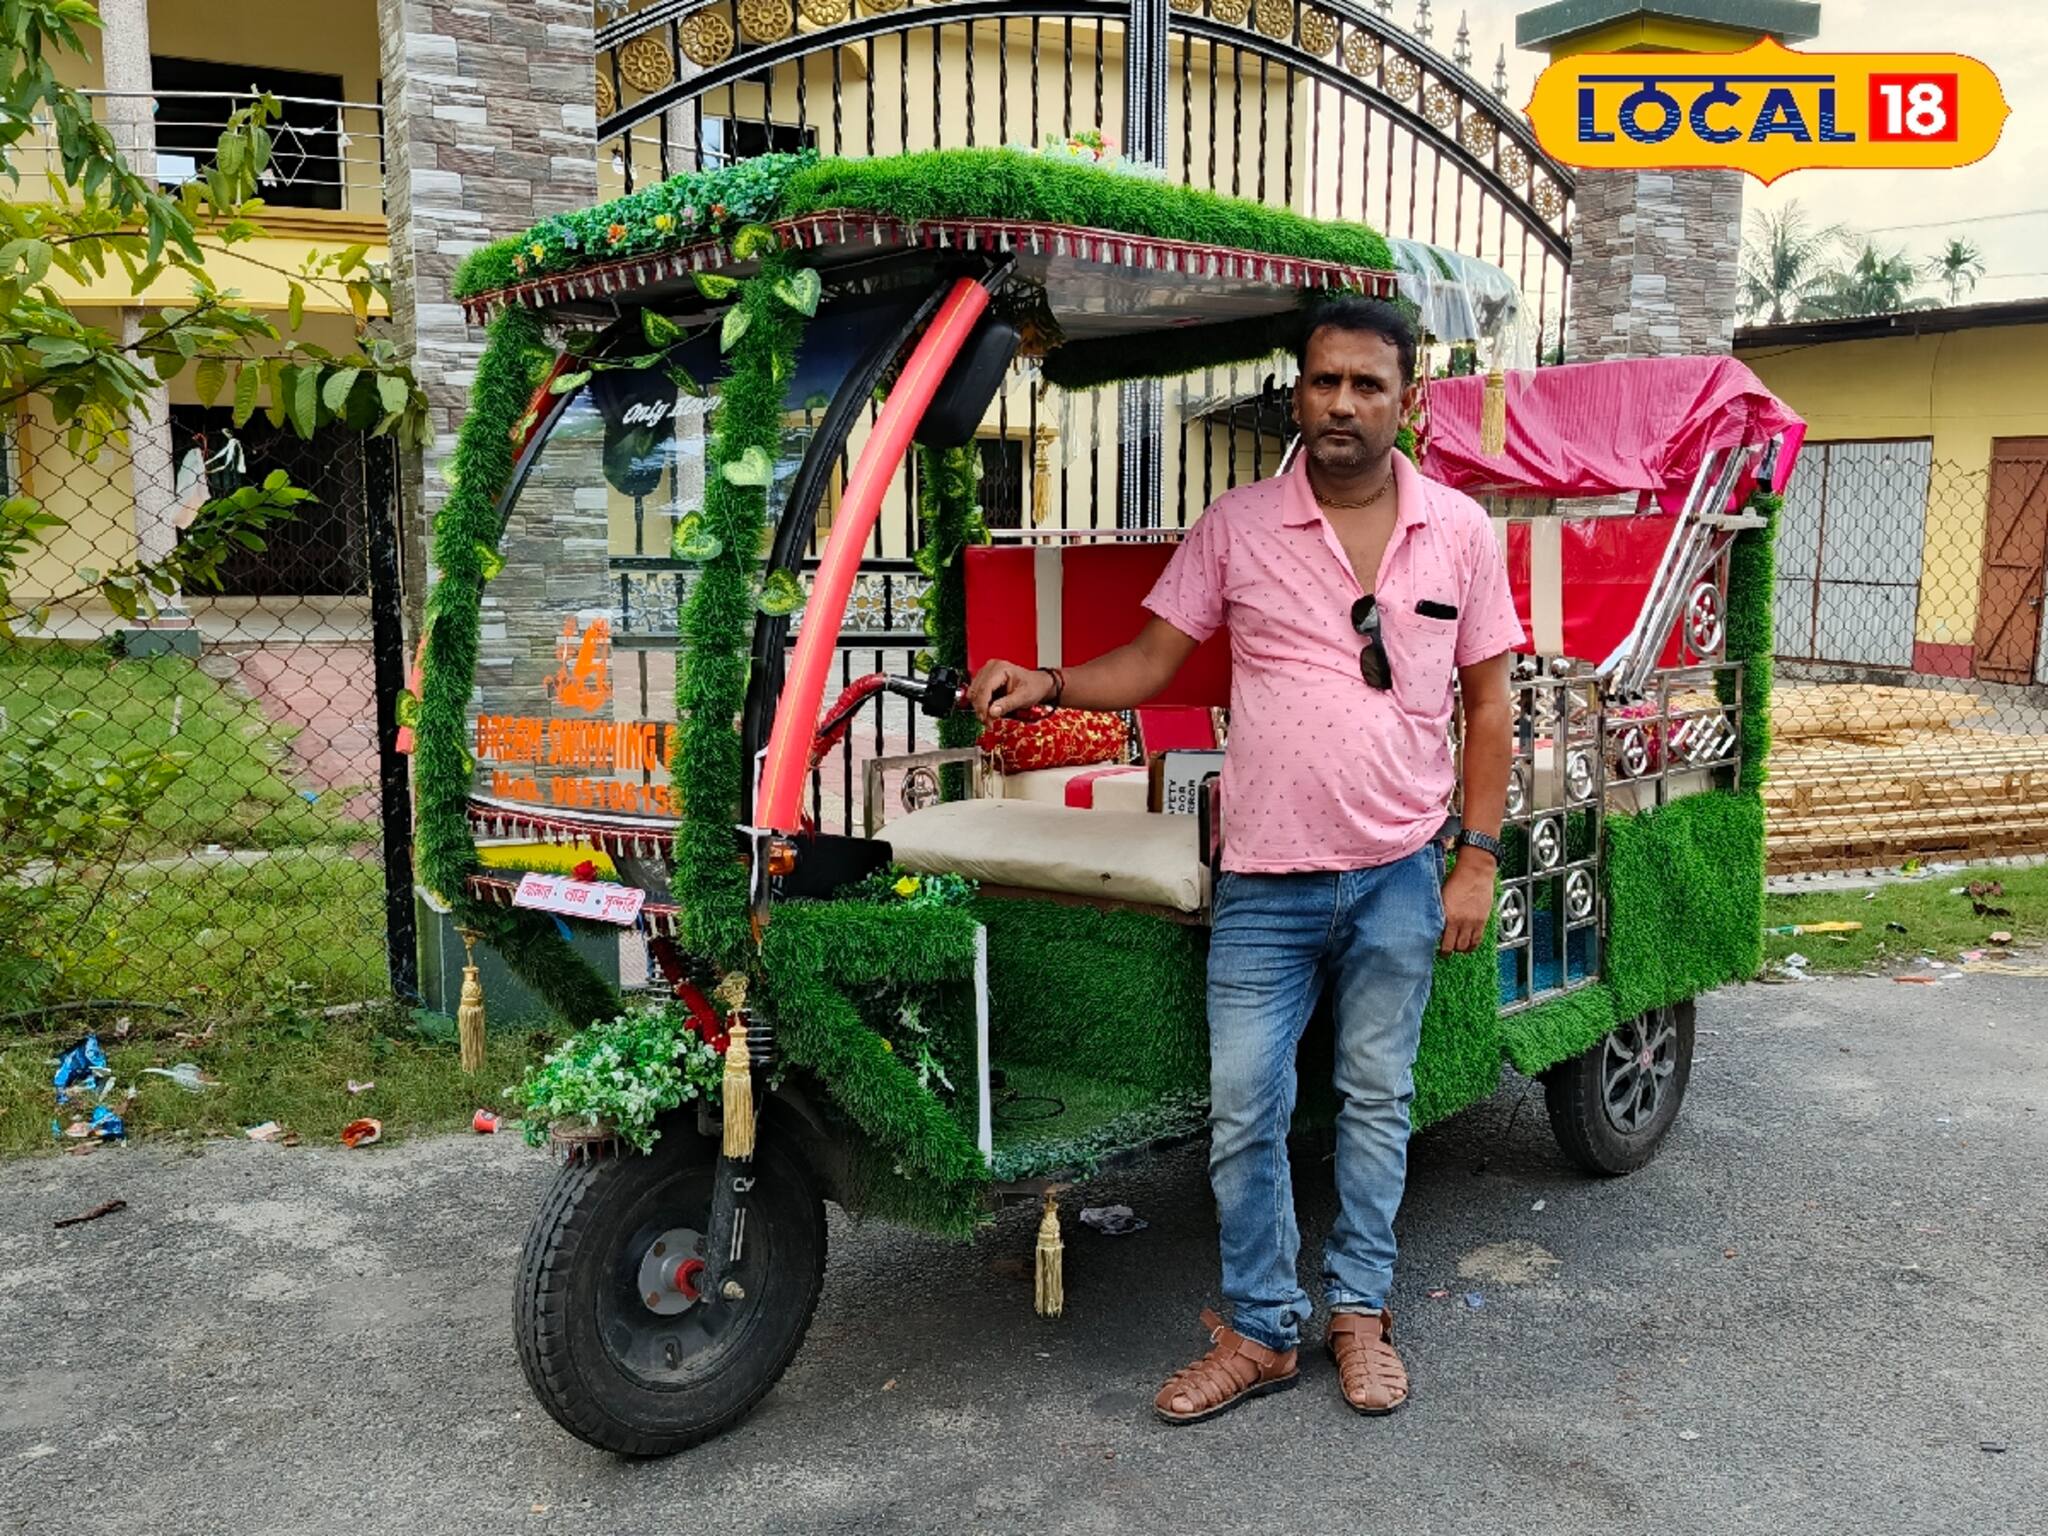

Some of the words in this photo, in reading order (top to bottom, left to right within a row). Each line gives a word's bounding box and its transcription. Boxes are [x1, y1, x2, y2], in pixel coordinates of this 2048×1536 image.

[622, 399, 671, 428] Only
[477, 714, 544, 764] DREAM
[547, 717, 657, 772] SWIMMING
[564, 886, 591, 904] নাম
